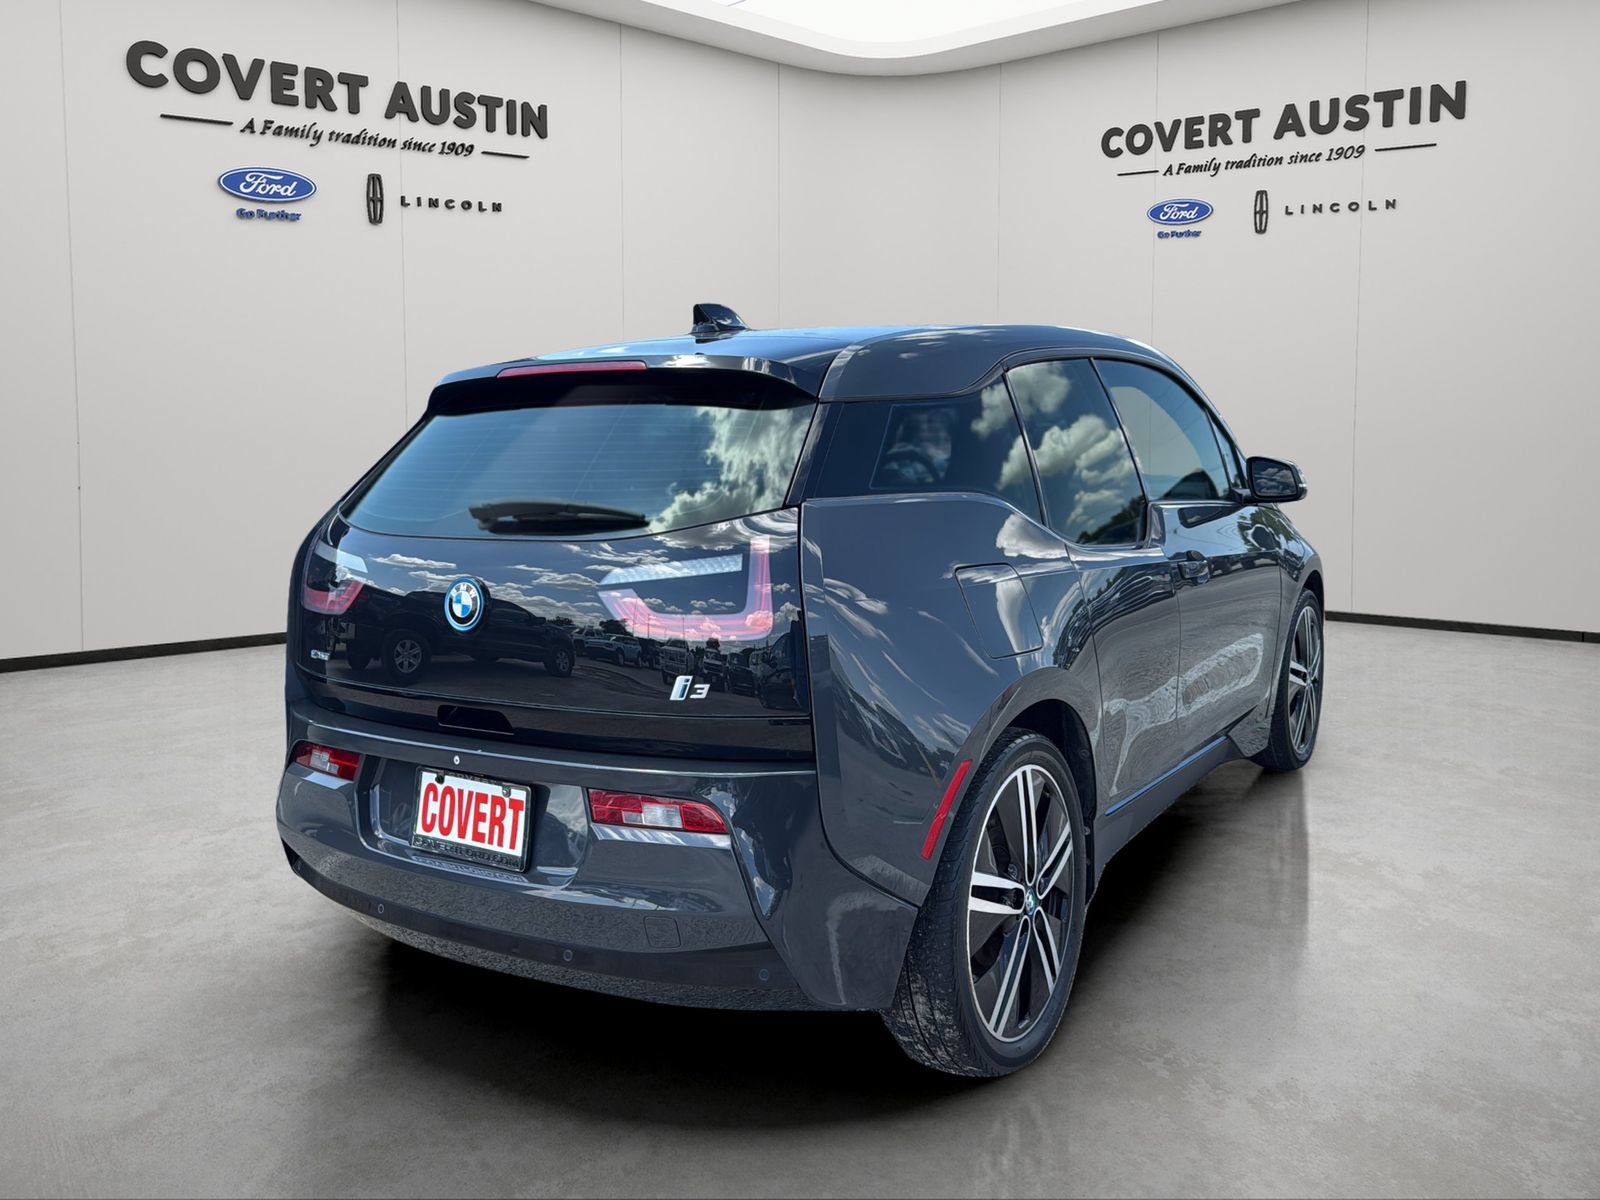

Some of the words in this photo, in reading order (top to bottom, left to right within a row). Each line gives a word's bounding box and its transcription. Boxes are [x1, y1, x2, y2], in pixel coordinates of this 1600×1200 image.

[125, 40, 369, 115] COVERT
[384, 81, 548, 140] AUSTIN
[1101, 108, 1261, 159] COVERT
[1273, 80, 1467, 141] AUSTIN
[239, 117, 256, 135] A
[259, 119, 324, 148] Family
[327, 127, 398, 150] tradition
[399, 136, 437, 154] since
[438, 141, 475, 157] 1909
[1162, 163, 1174, 177] A
[1175, 156, 1222, 178] Family
[1224, 152, 1284, 171] tradition
[1287, 150, 1323, 166] since
[1325, 143, 1366, 162] 1909
[239, 171, 298, 197] Ford
[400, 195, 503, 213] LINCOLN
[1159, 203, 1200, 220] Ford
[1284, 198, 1397, 217] LINCOLN
[669, 675, 711, 701] i3
[420, 782, 525, 851] COVERT
